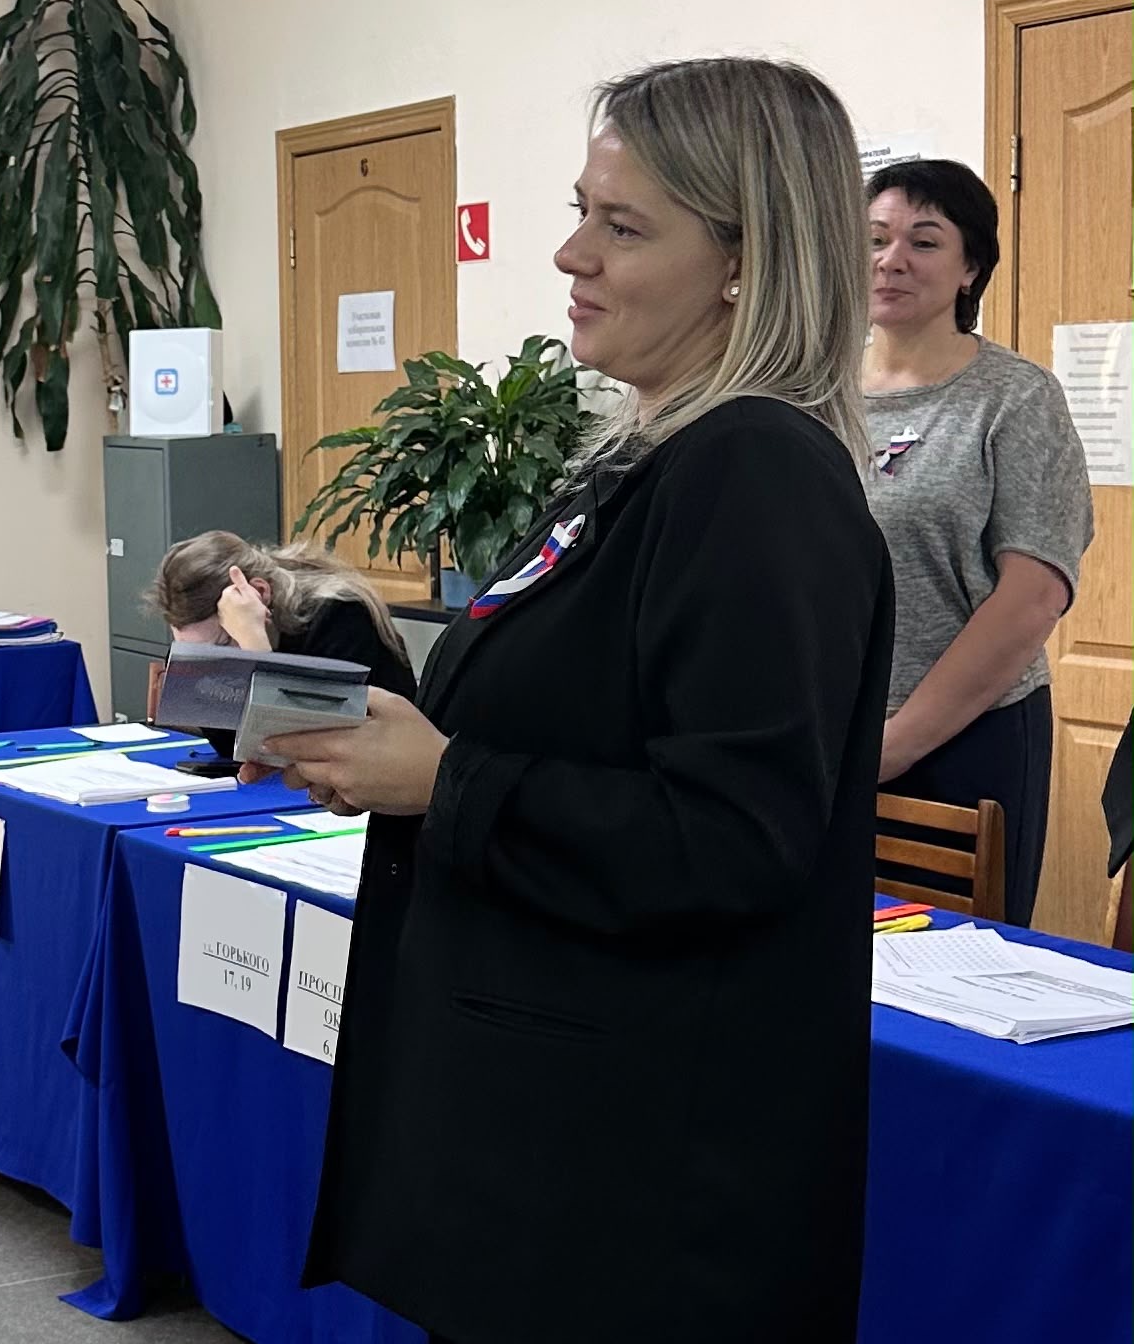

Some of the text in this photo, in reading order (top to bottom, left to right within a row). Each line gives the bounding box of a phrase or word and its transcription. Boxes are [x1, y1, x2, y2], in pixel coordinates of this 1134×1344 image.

[216, 941, 270, 973] ГОРЬКОГО
[224, 968, 252, 992] 17, 19
